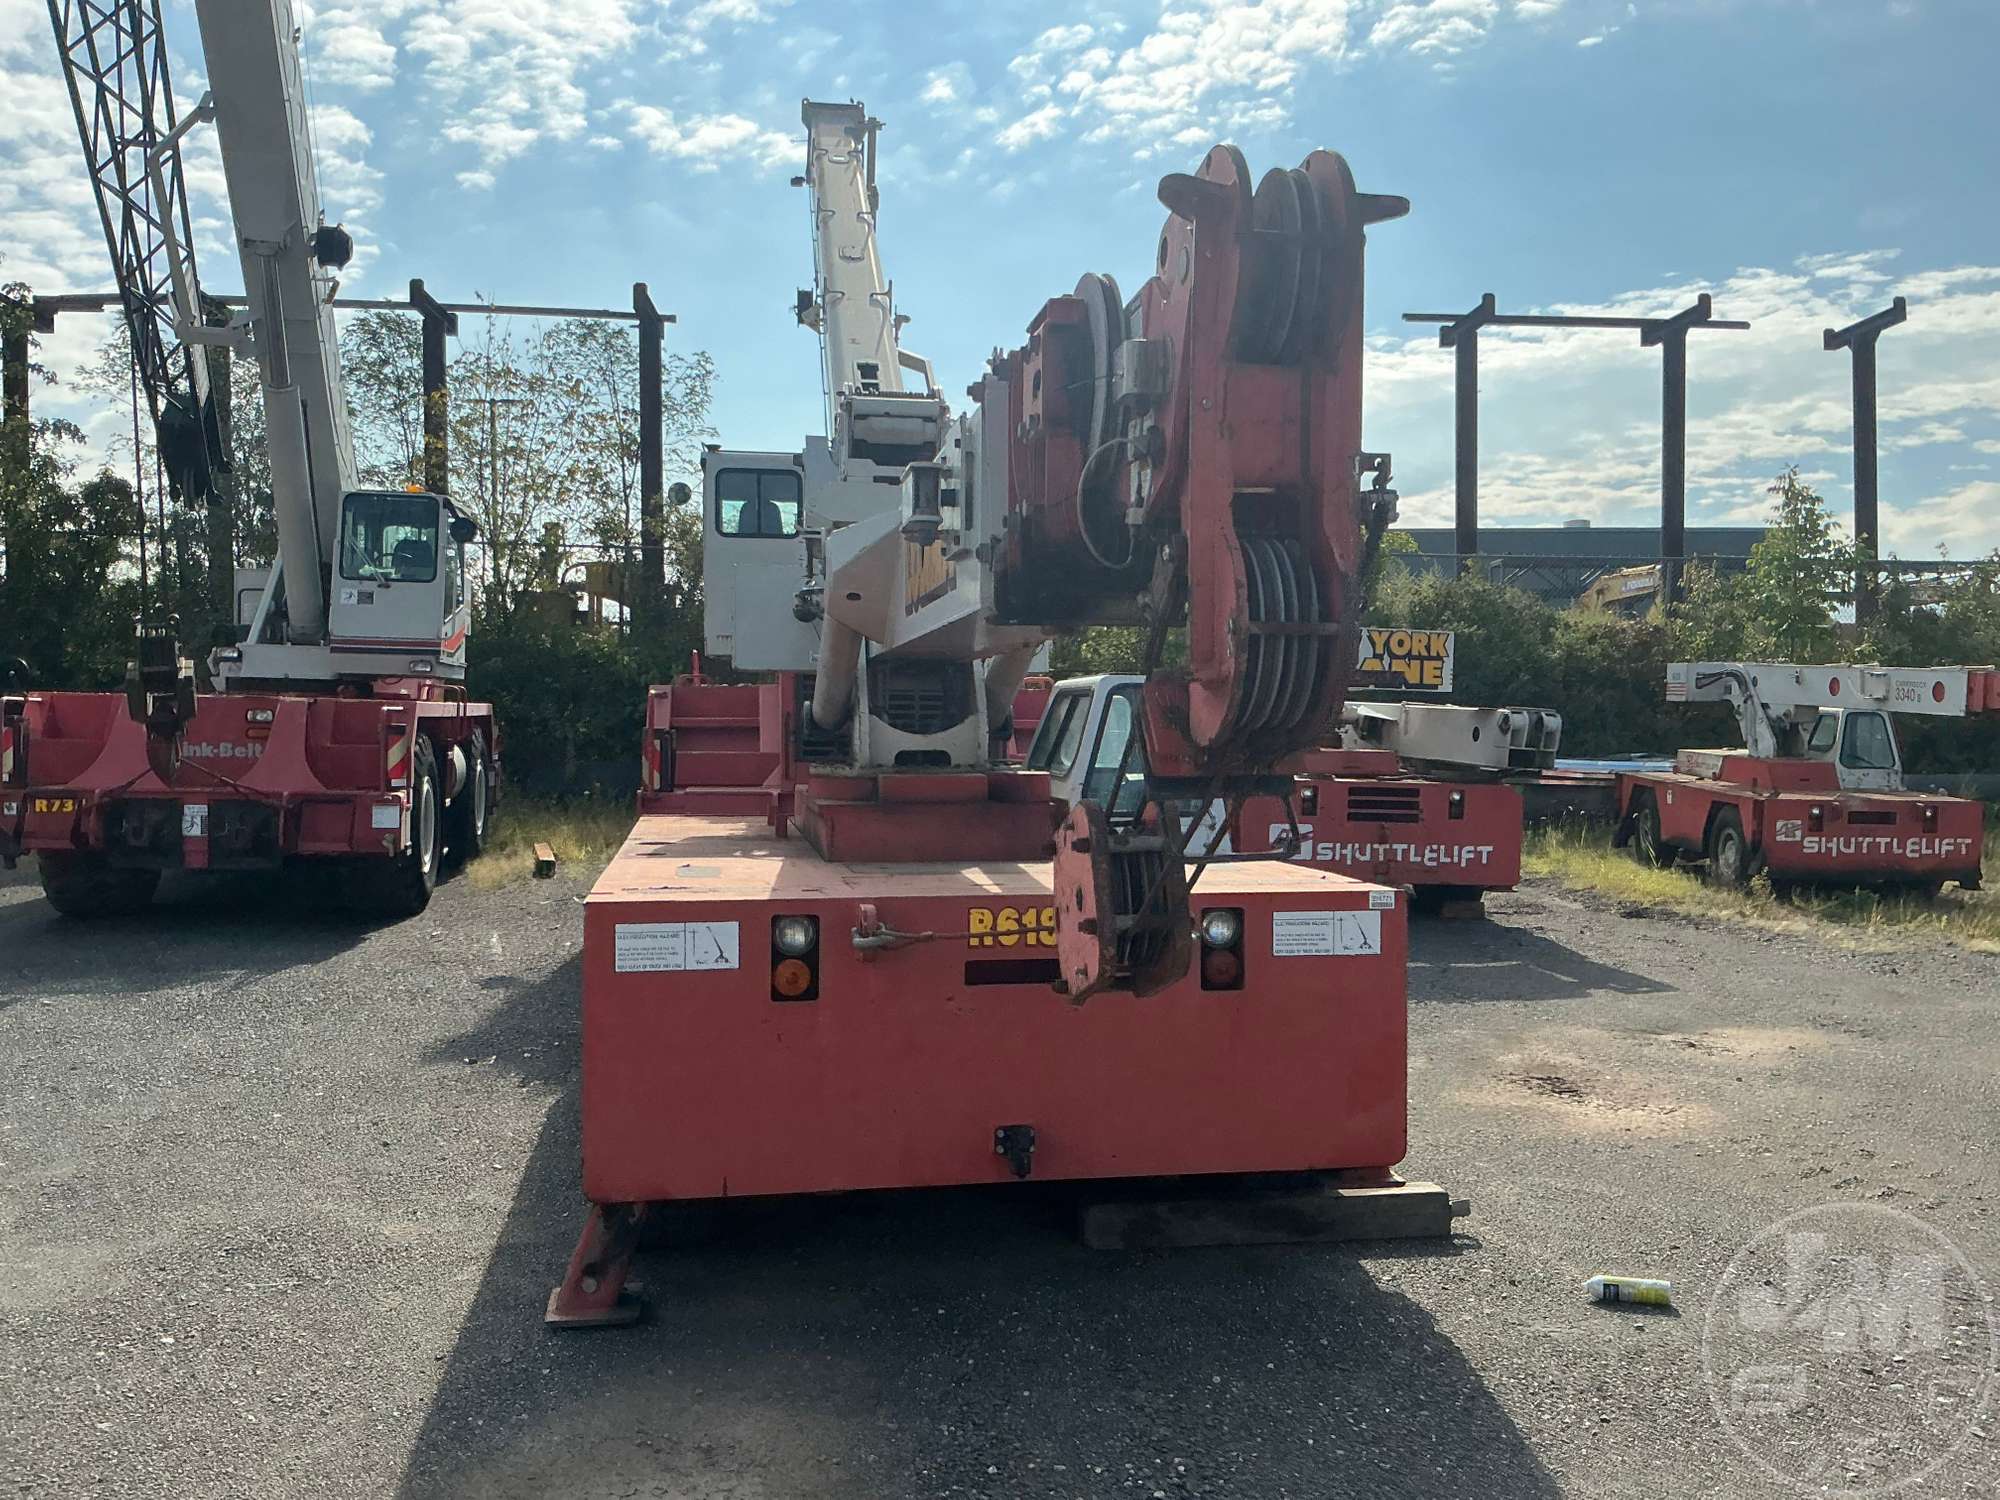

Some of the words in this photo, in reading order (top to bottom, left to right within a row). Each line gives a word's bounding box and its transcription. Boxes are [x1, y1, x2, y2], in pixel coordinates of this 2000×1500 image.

[1368, 630, 1449, 657] YORK
[1895, 688, 1916, 702] 3340
[181, 741, 263, 758] ink-Belt
[1316, 842, 1494, 867] SHUTTLELIFT
[1803, 836, 1972, 859] SHUTTLELIFT
